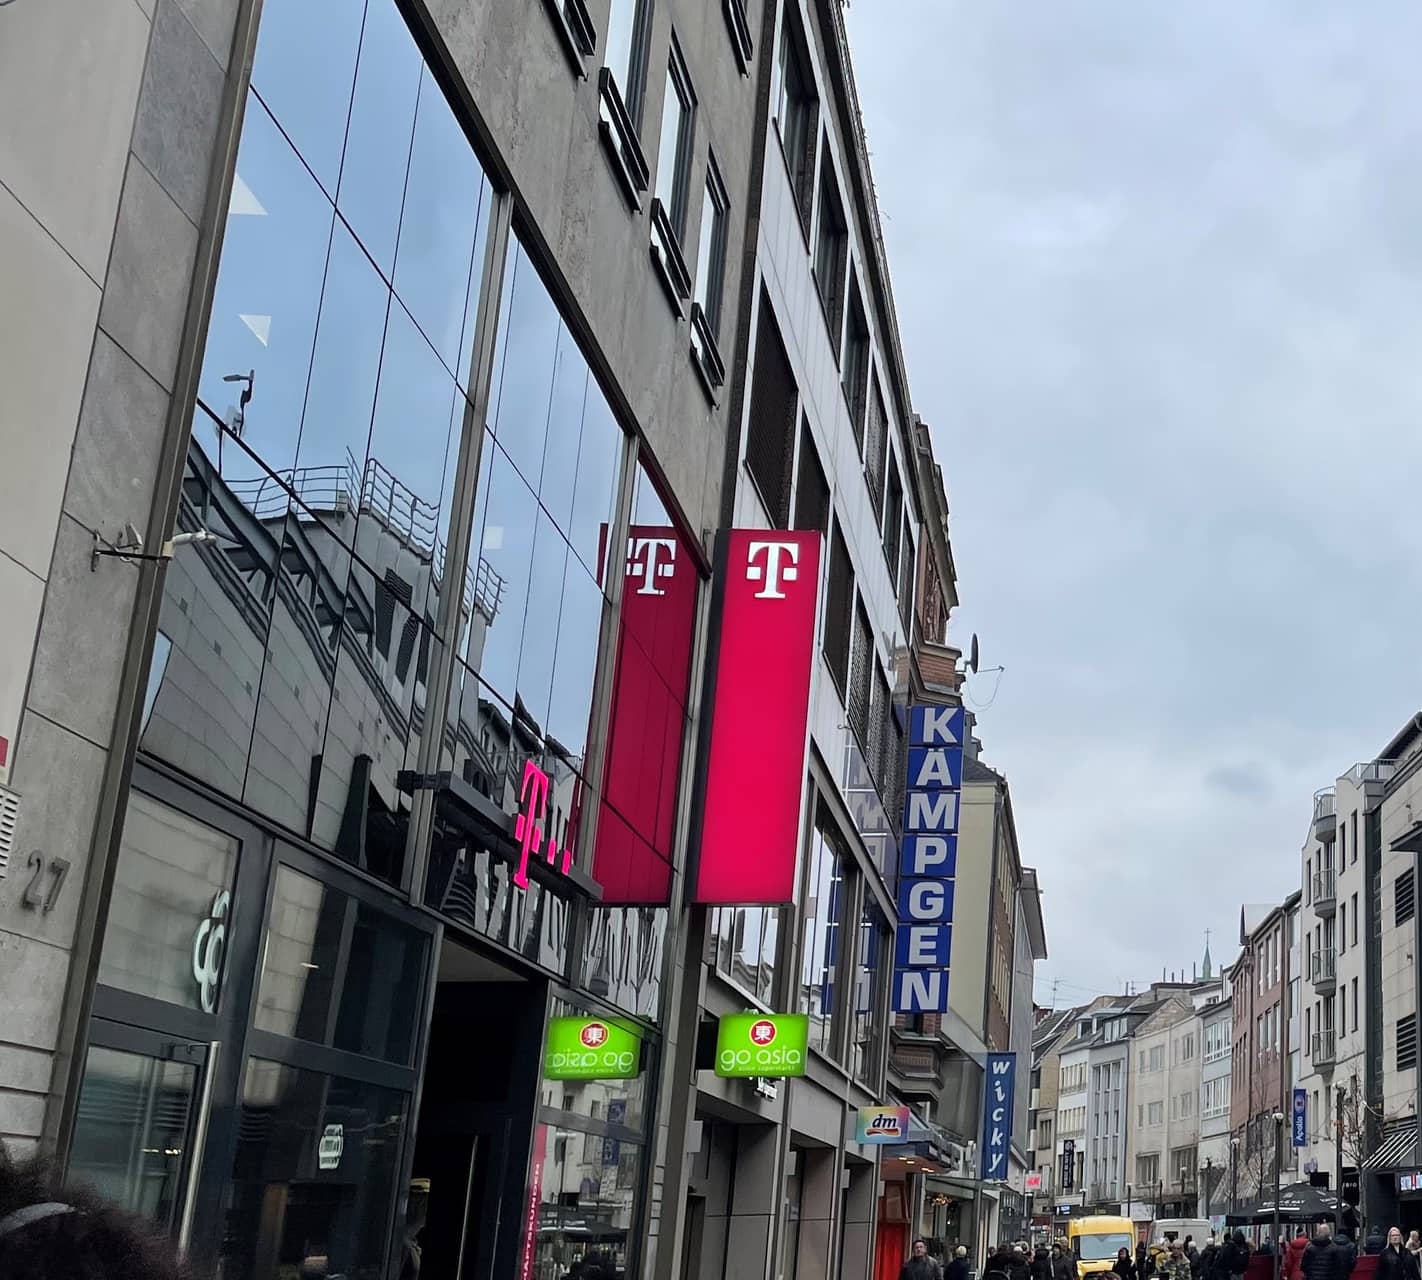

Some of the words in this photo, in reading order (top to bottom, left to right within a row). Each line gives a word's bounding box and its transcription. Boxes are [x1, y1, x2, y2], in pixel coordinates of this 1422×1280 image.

[746, 541, 799, 599] T
[22, 849, 71, 911] 27
[900, 707, 959, 1011] KÄMPGEN
[755, 1025, 771, 1041] 東
[721, 1050, 751, 1071] go
[756, 1045, 800, 1064] asia
[872, 1114, 897, 1129] dm
[989, 1061, 1010, 1173] wicky
[1295, 1116, 1304, 1141] Apollo
